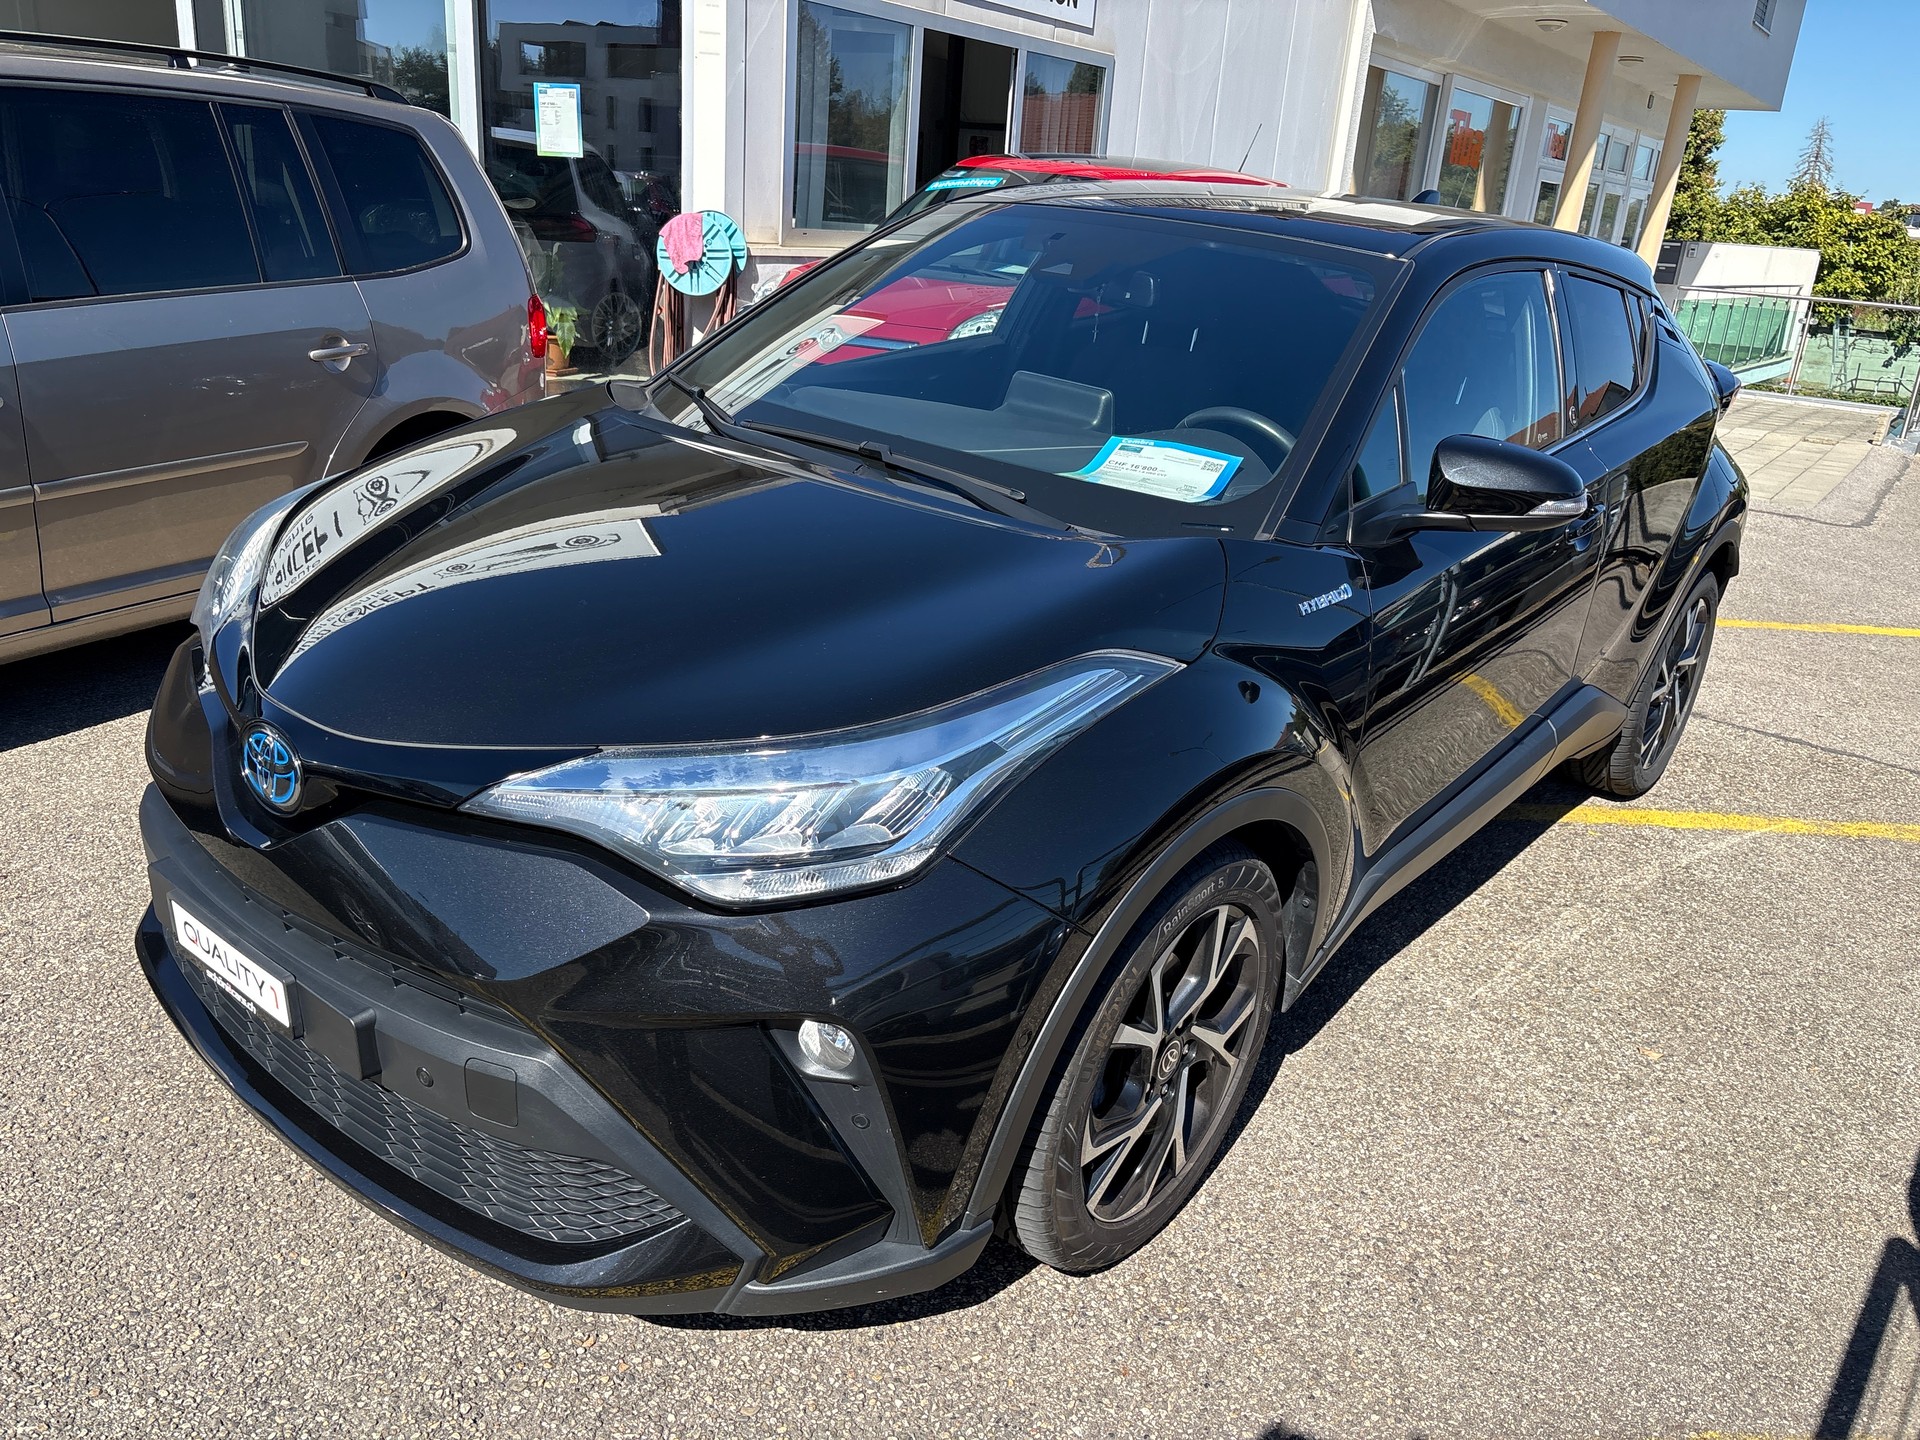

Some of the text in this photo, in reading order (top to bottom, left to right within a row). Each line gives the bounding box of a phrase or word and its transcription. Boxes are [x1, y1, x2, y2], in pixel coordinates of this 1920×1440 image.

[930, 178, 998, 189] Automatique
[1108, 459, 1127, 467] CHF
[1298, 583, 1353, 616] HYBRID
[1162, 876, 1226, 936] RainSport 5
[1079, 965, 1146, 1084] UNIROYAL
